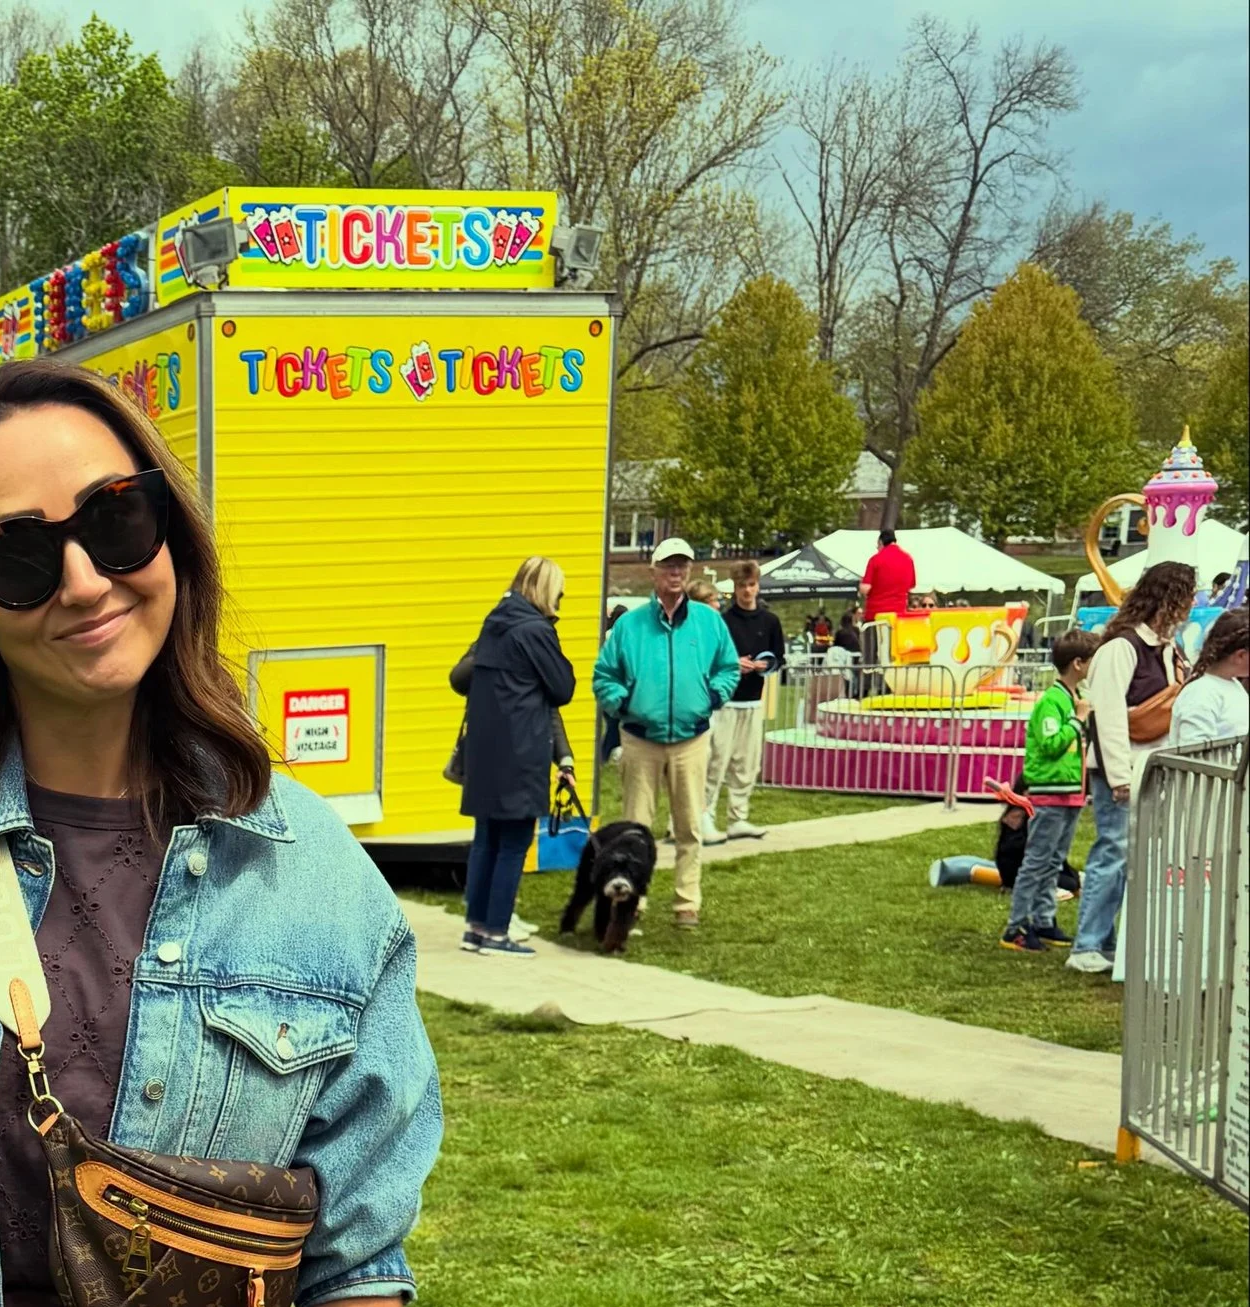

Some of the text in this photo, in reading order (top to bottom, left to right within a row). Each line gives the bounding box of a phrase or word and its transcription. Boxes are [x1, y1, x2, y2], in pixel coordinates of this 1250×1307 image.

[295, 207, 491, 267] TICKETS
[239, 345, 585, 400] TICKETS TICKETS
[289, 694, 346, 712] DANGER
[305, 727, 329, 736] HIGH
[296, 741, 337, 751] VOLTAGE
